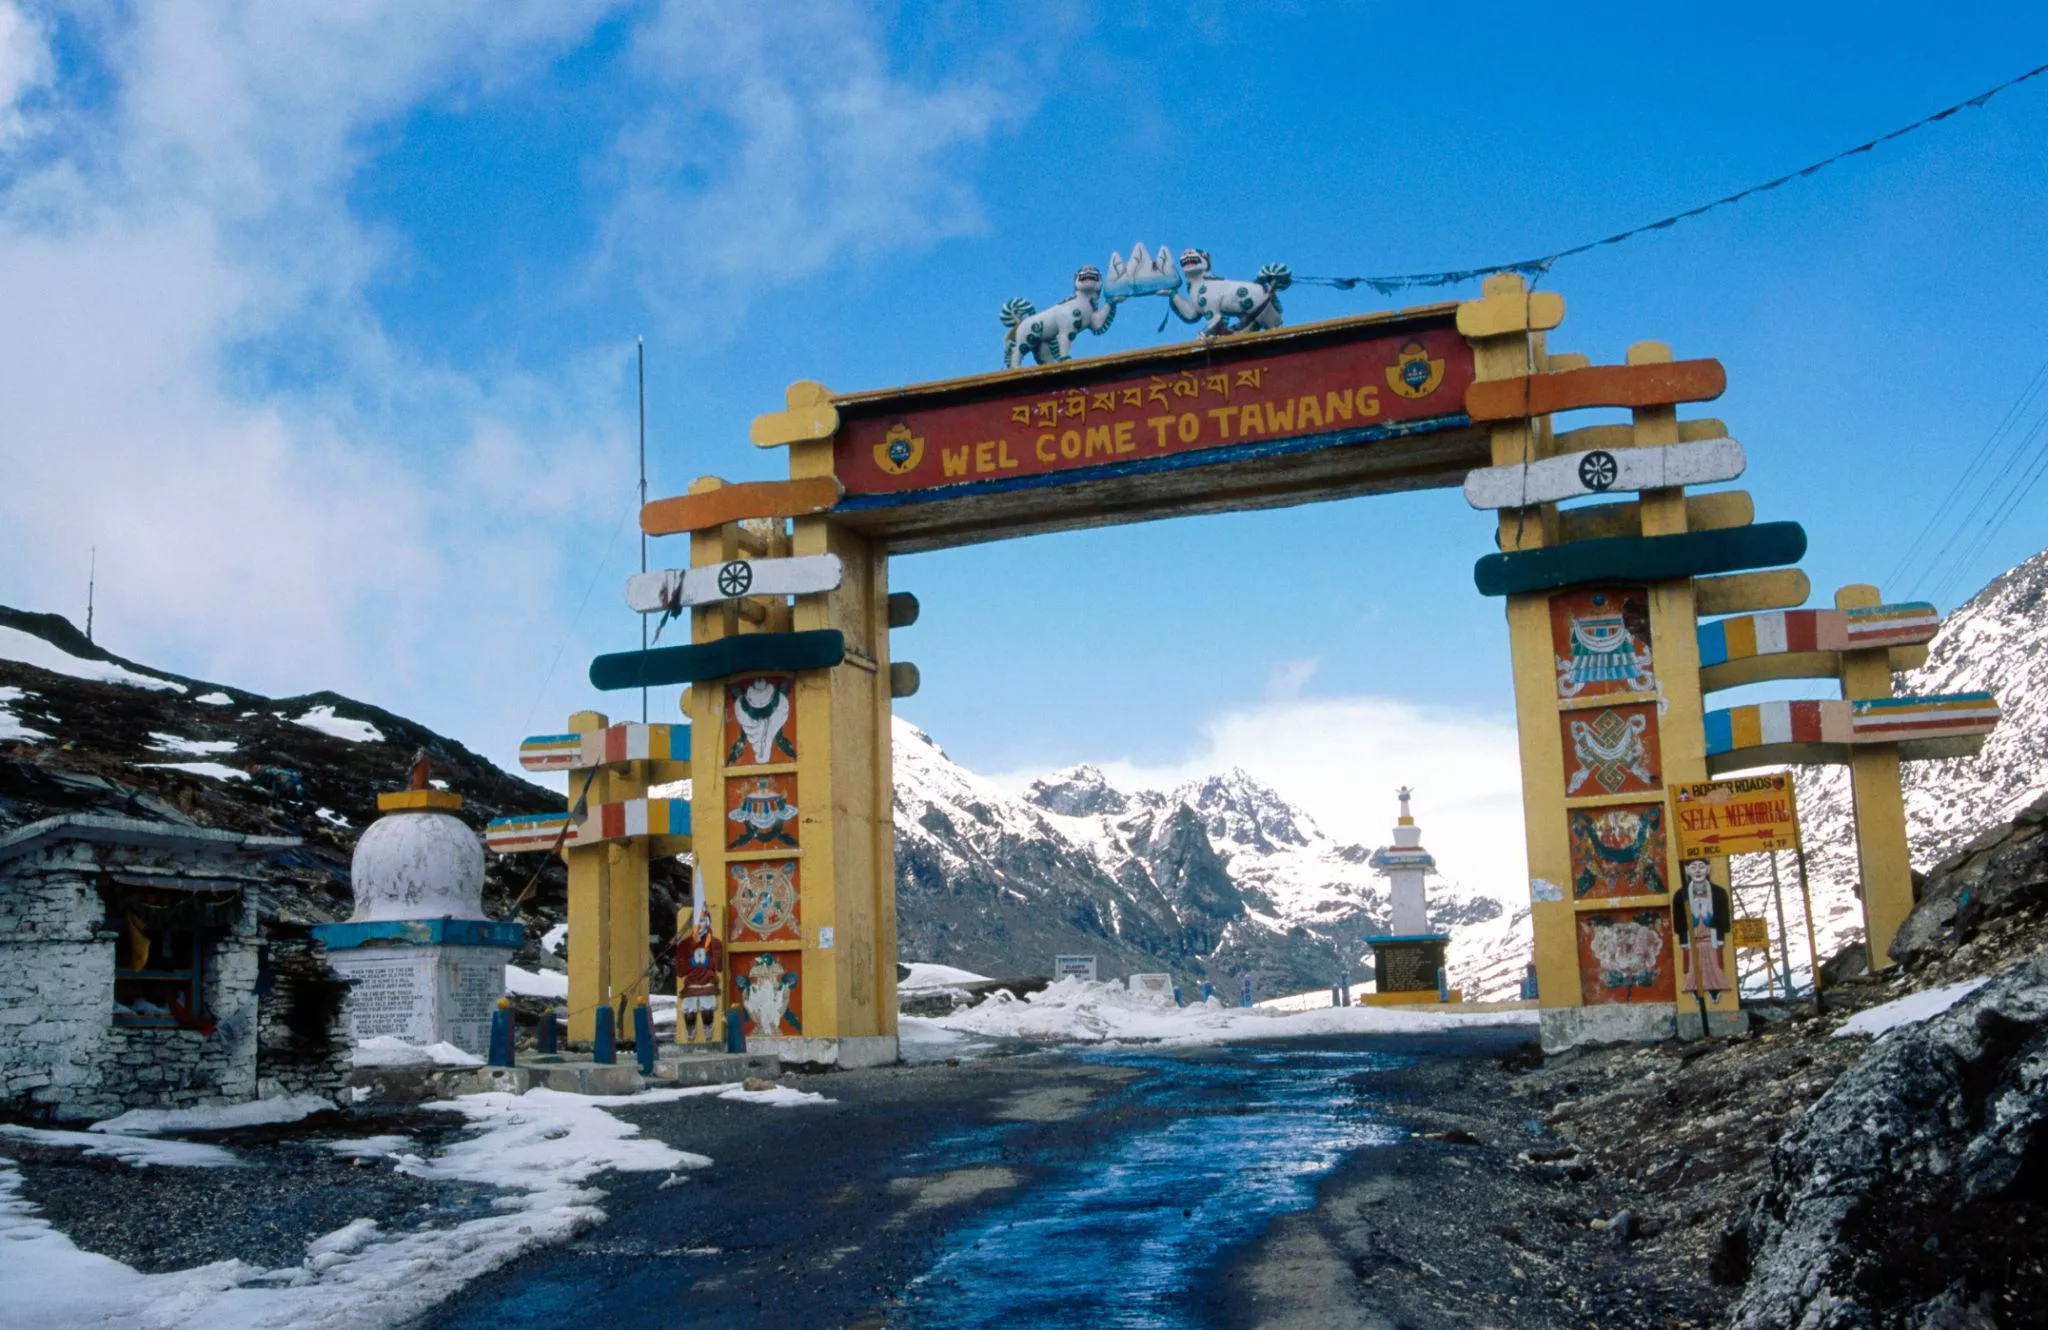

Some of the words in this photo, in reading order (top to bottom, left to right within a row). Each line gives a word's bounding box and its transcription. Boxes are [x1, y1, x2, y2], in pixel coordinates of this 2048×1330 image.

[942, 439, 1018, 477] WEL
[1035, 421, 1137, 463] COME
[1148, 412, 1200, 448] TO
[1206, 386, 1381, 437] TAWANG
[1735, 777, 1772, 792] ROADS
[1680, 806, 1719, 831] SELA
[1725, 800, 1790, 828] MEMORIAL
